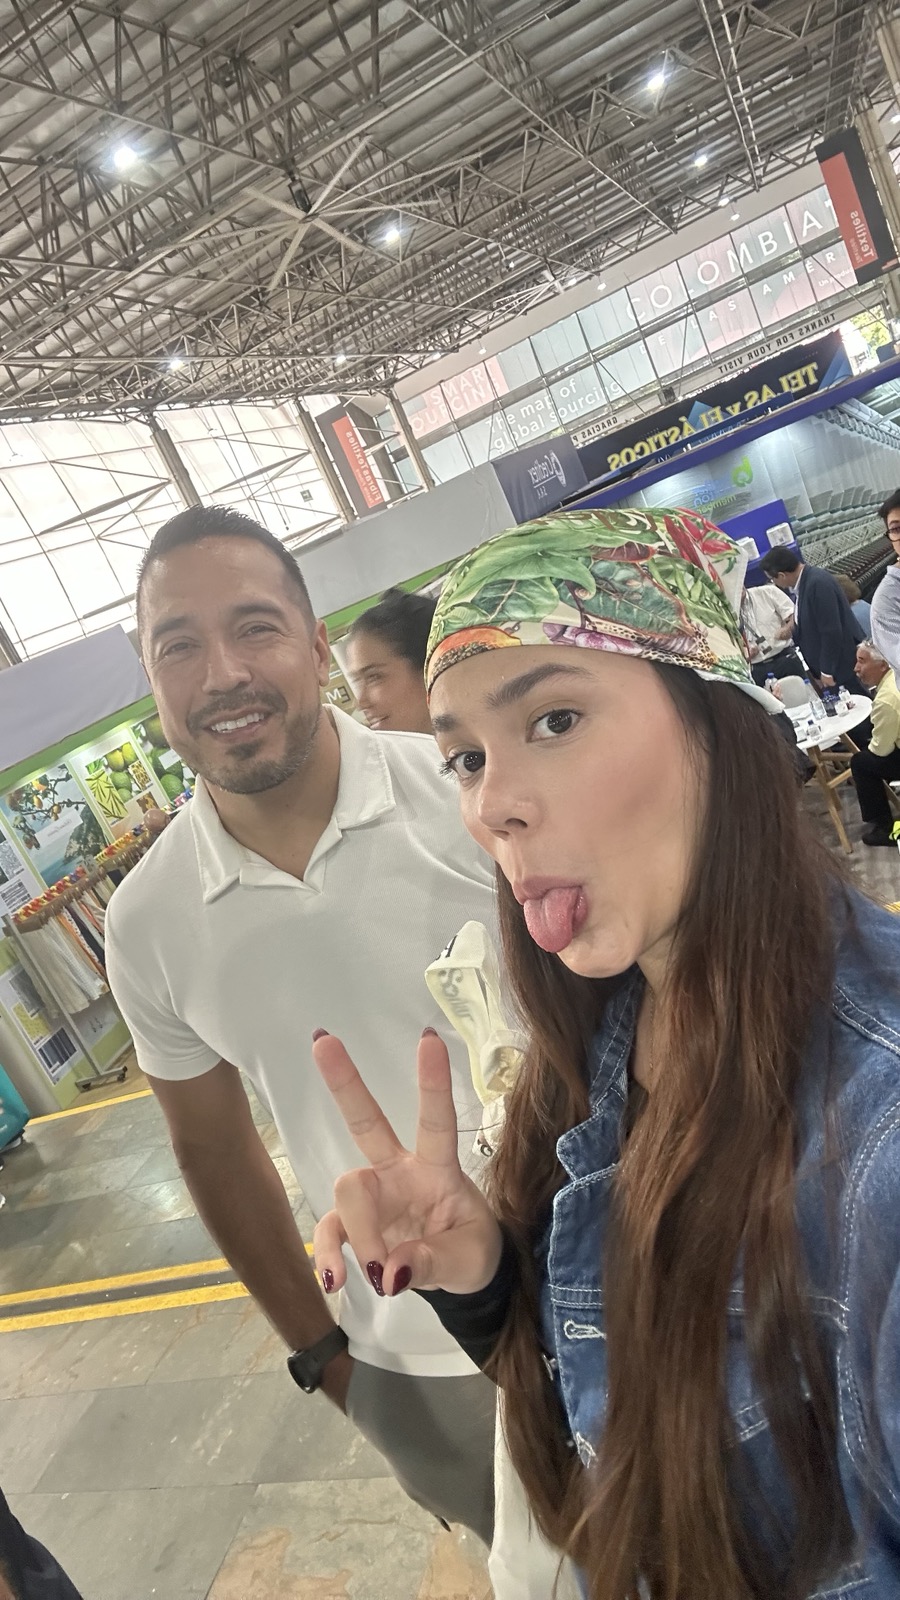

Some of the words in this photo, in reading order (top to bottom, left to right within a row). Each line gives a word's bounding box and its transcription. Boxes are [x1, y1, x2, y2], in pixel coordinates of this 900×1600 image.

[691, 299, 737, 329] LAS
[411, 377, 501, 433] OURCING
[430, 362, 495, 405] SMART
[485, 411, 515, 434] The
[520, 397, 555, 423] map
[560, 378, 577, 399] of
[493, 419, 545, 452] global
[550, 381, 621, 424] sourcing
